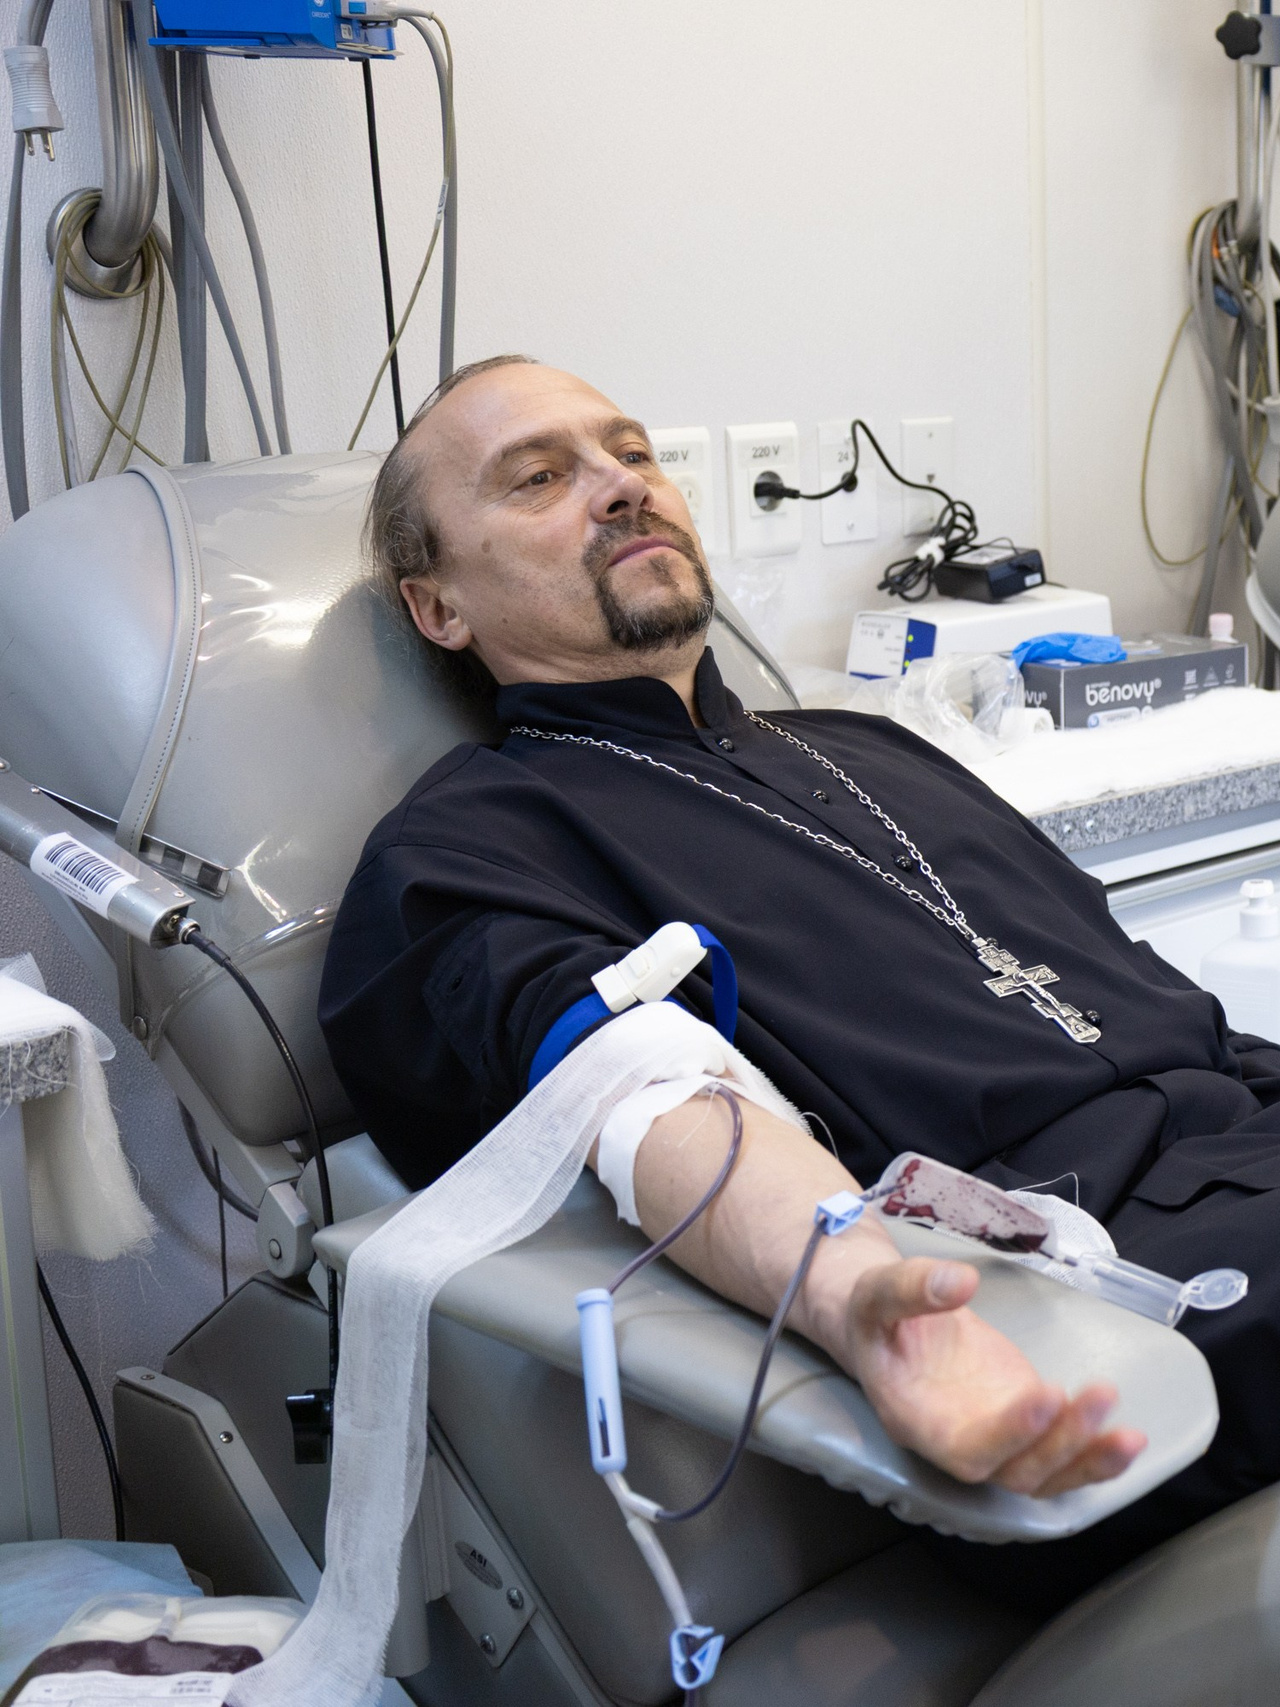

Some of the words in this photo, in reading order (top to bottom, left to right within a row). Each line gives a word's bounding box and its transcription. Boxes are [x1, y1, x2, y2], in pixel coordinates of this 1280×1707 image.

[659, 450, 679, 462] 220
[681, 449, 689, 461] V
[752, 446, 770, 459] 220
[771, 444, 780, 456] V
